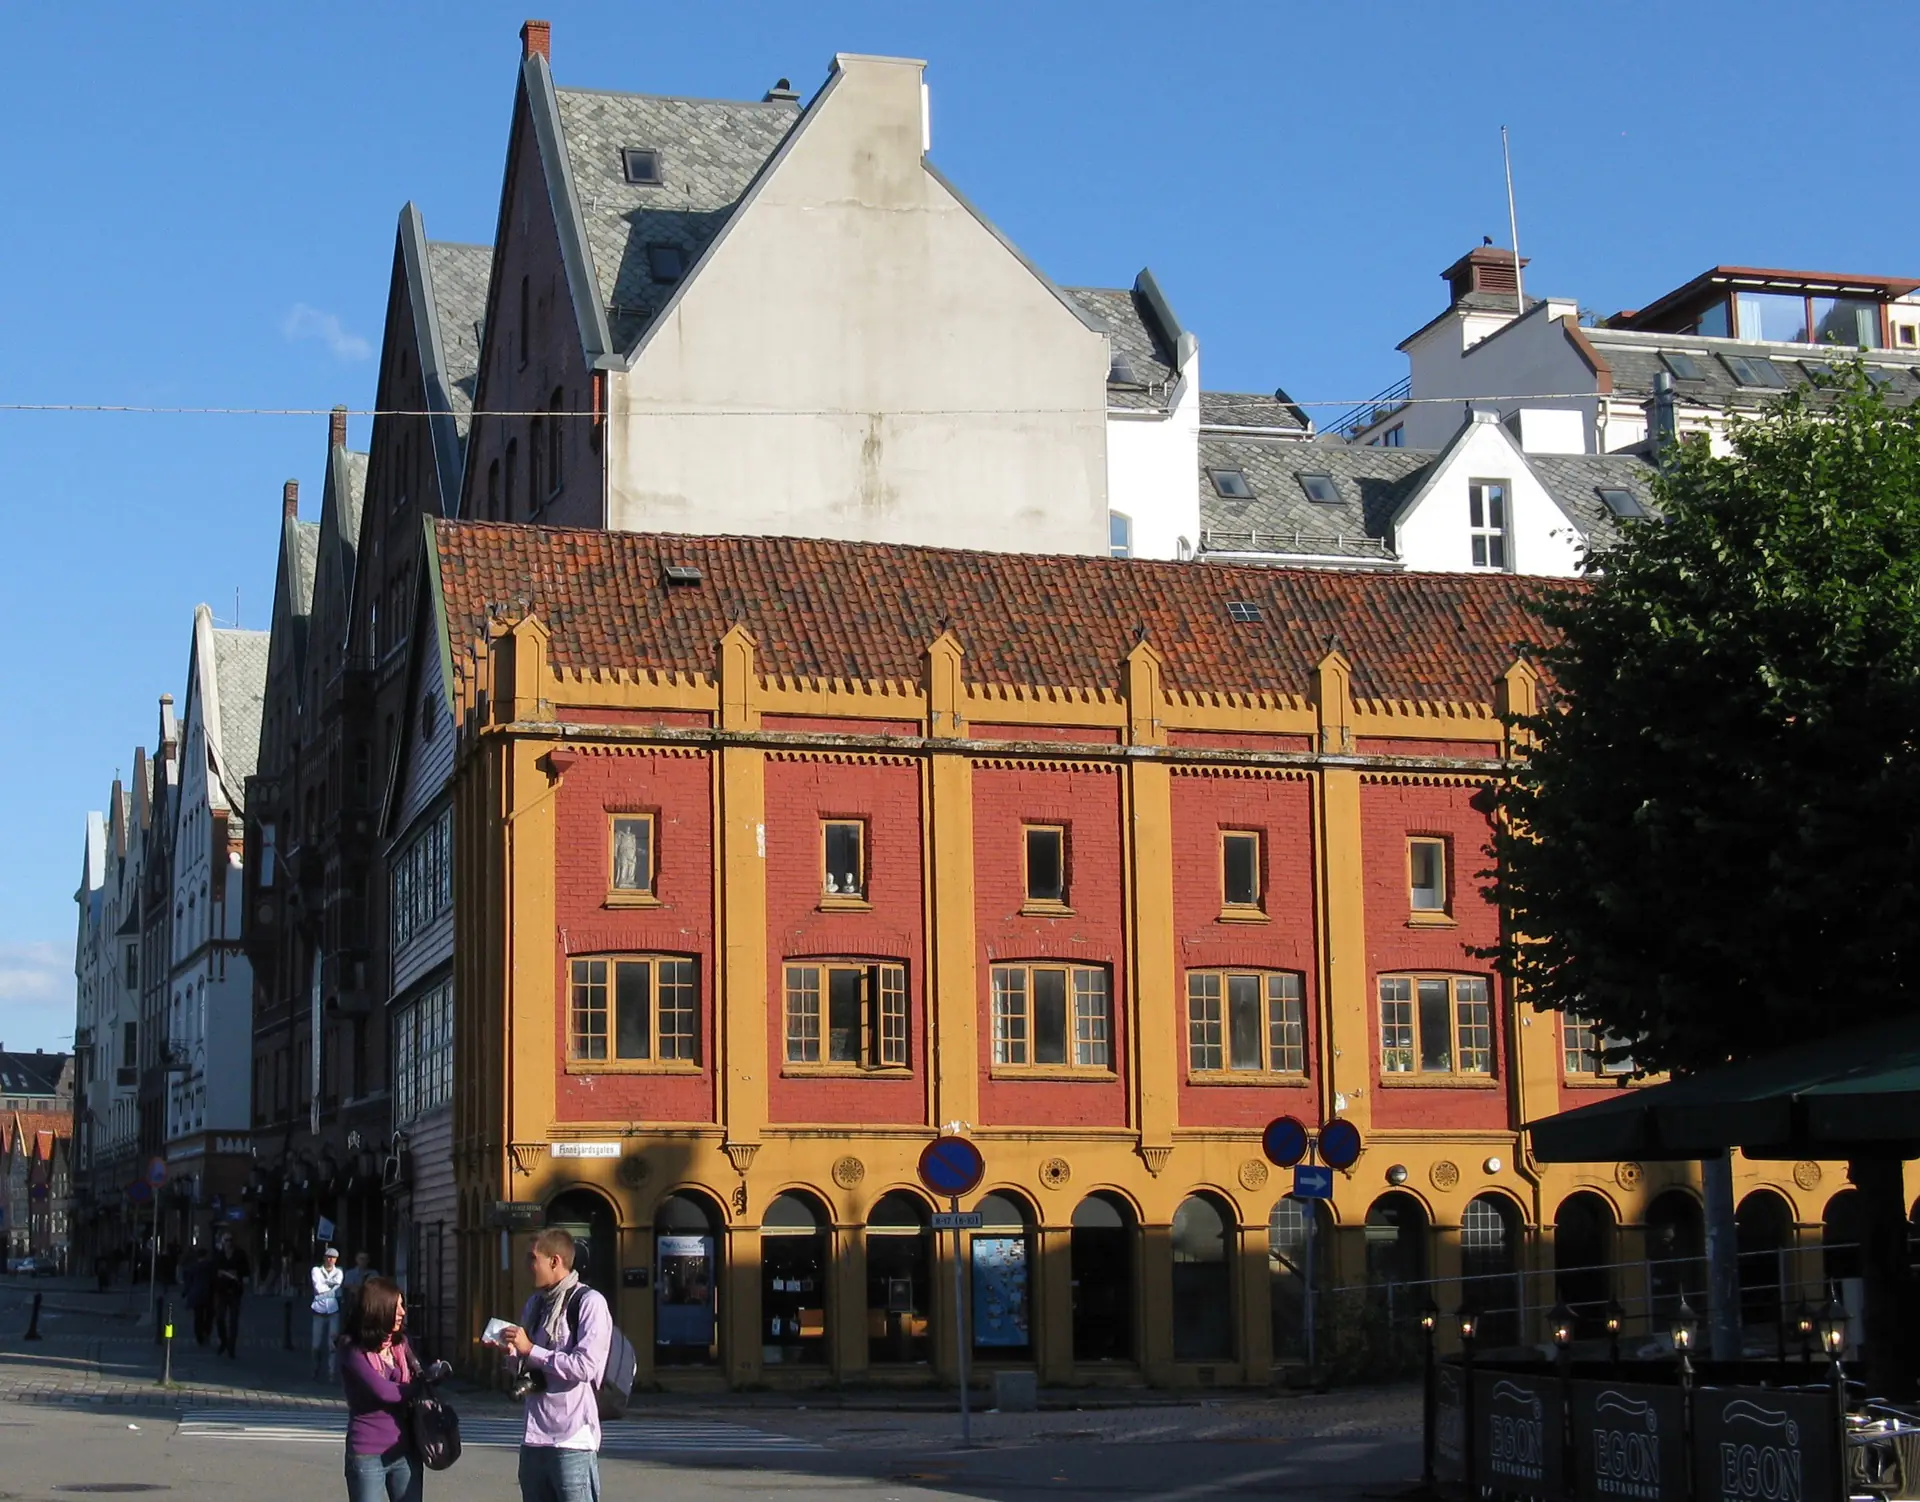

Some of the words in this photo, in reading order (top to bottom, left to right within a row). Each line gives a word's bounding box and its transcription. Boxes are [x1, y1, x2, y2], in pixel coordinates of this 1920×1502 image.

[1490, 1413, 1543, 1466] EGON
[1592, 1429, 1661, 1484] EGON
[1491, 1459, 1543, 1481] RESTAURANT
[1596, 1478, 1661, 1500] RESTAURANT
[1720, 1442, 1802, 1502] EGON
